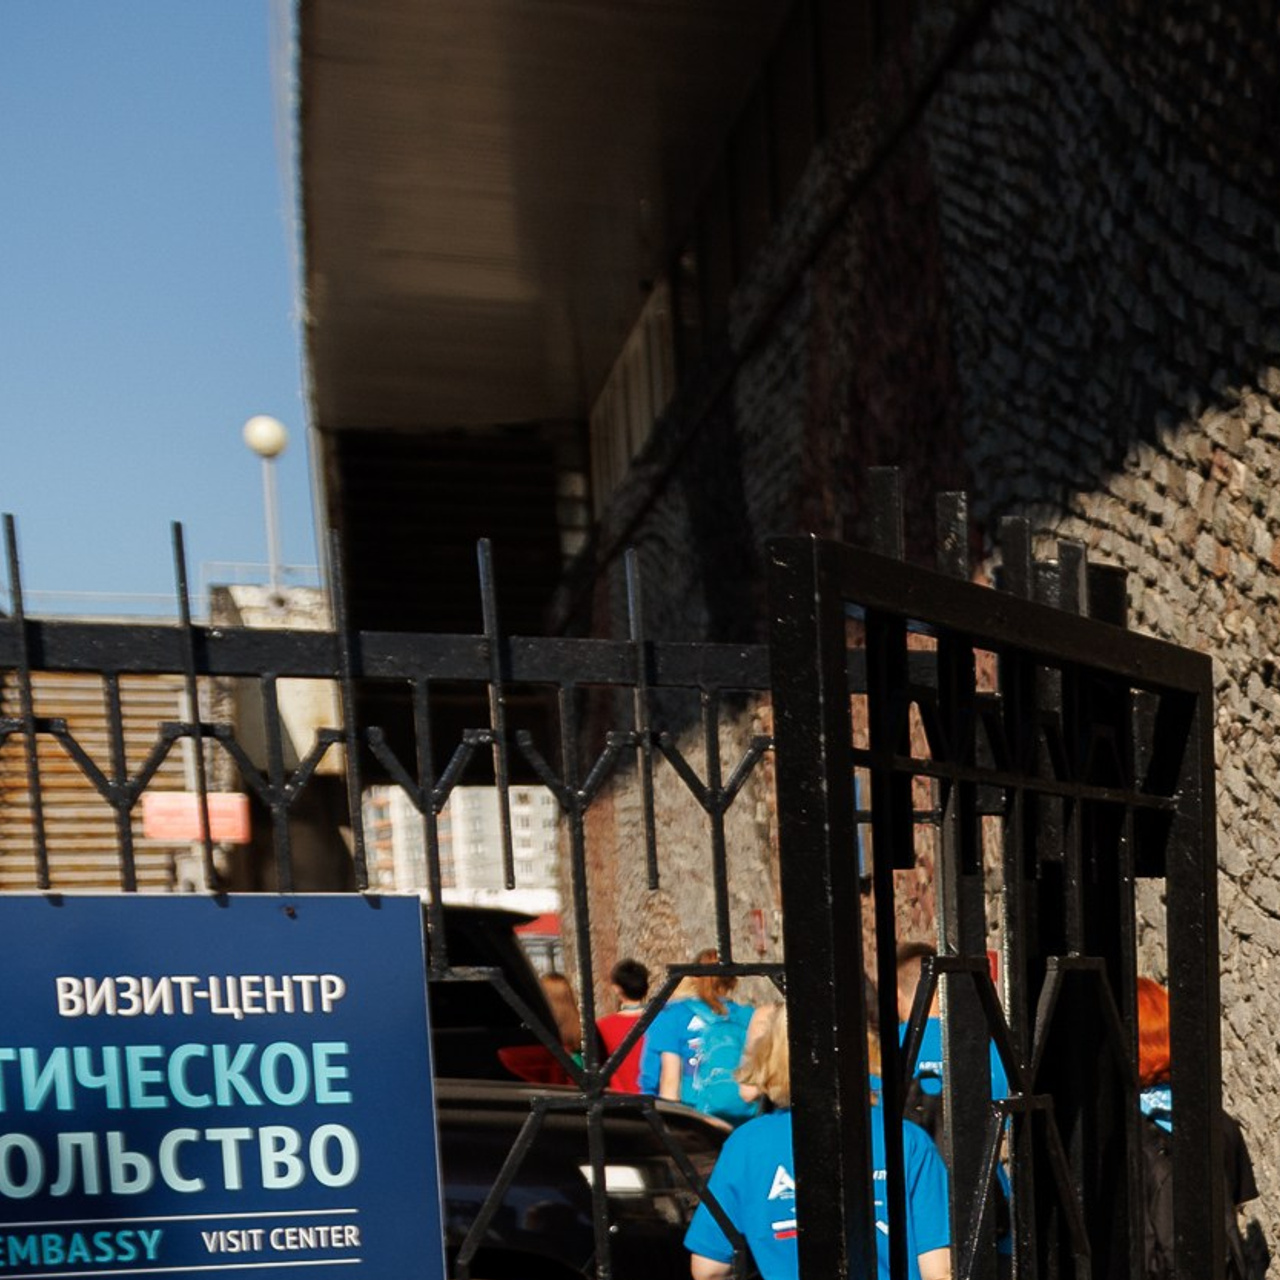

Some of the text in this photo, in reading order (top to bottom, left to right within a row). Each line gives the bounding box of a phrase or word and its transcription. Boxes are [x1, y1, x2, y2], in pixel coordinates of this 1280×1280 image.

[56, 974, 347, 1020] ВИЗИТ-ЦЕНТР
[0, 1123, 360, 1199] ОЛЬСТВО
[0, 1225, 361, 1267] MBASSY VISIT CENTER
